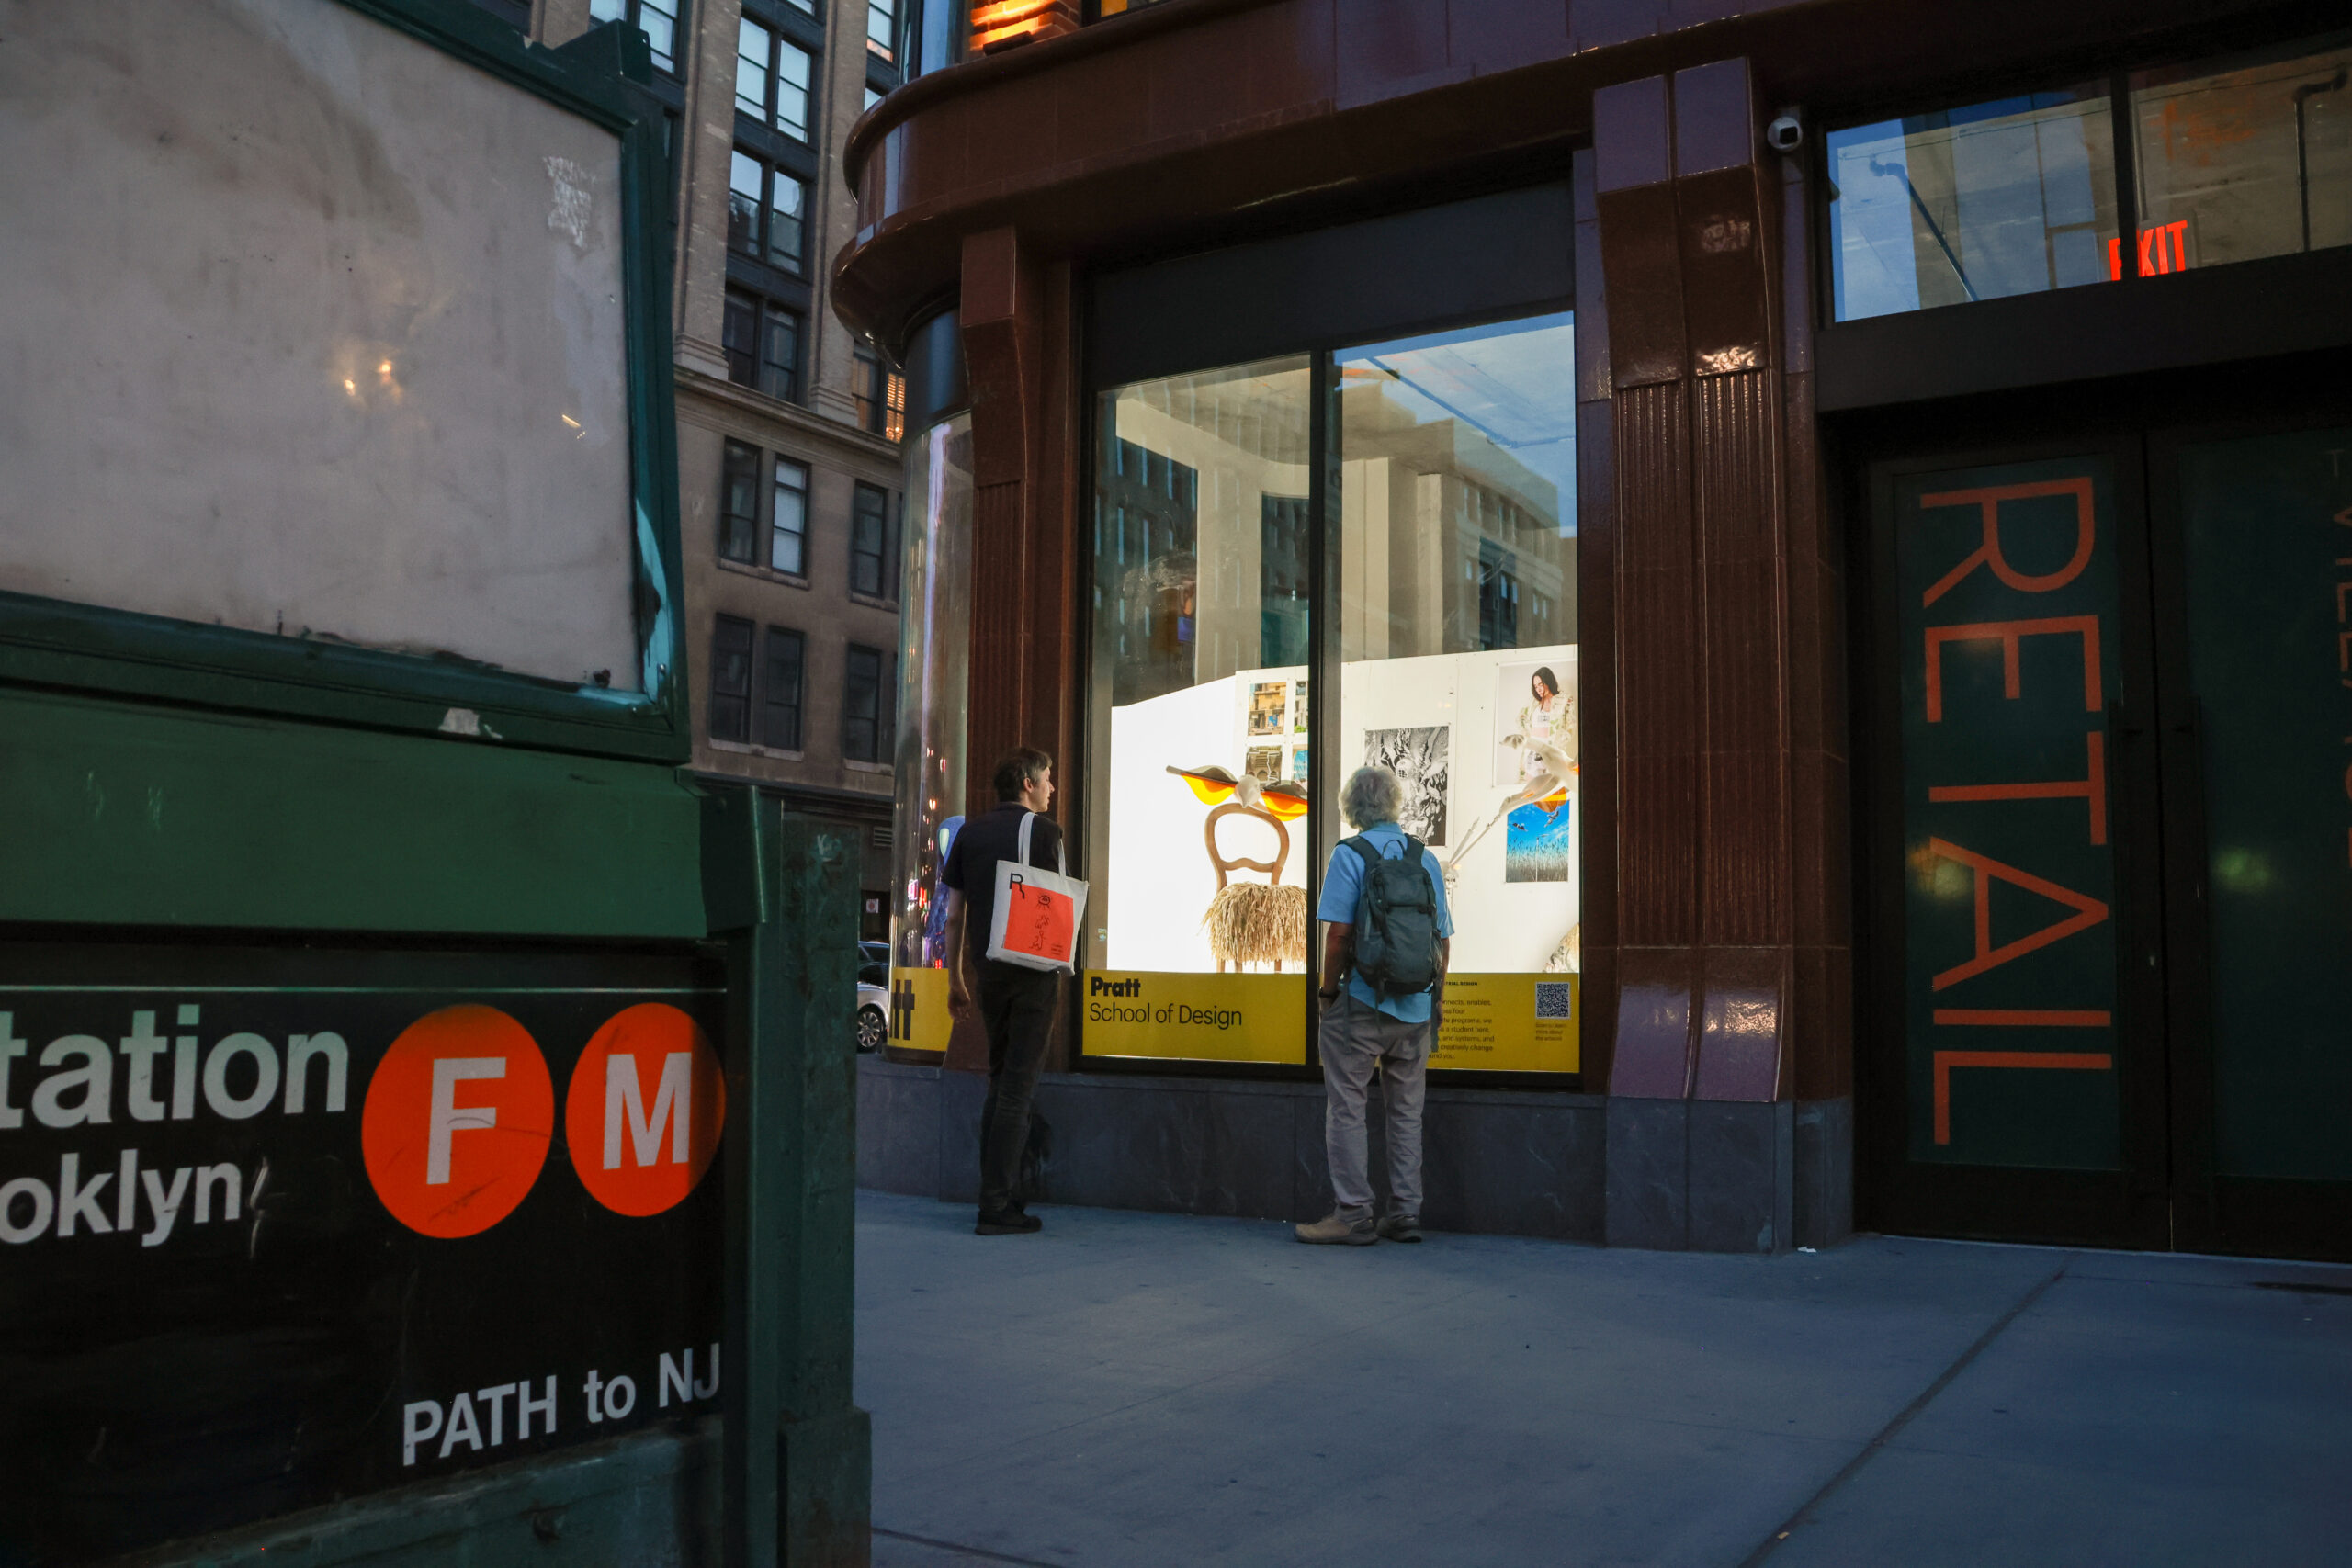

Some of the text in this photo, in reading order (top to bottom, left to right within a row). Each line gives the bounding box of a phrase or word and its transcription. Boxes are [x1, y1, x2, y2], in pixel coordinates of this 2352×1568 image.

[2108, 220, 2188, 281] EXIT
[1918, 475, 2112, 1145] RETAIL
[1089, 1001, 1242, 1030] School of Design
[1091, 976, 1141, 998] Pratt
[425, 1056, 507, 1186] F
[603, 1051, 693, 1171] M
[0, 1148, 242, 1247] oklyn
[402, 1342, 721, 1467] PATH to NJ
